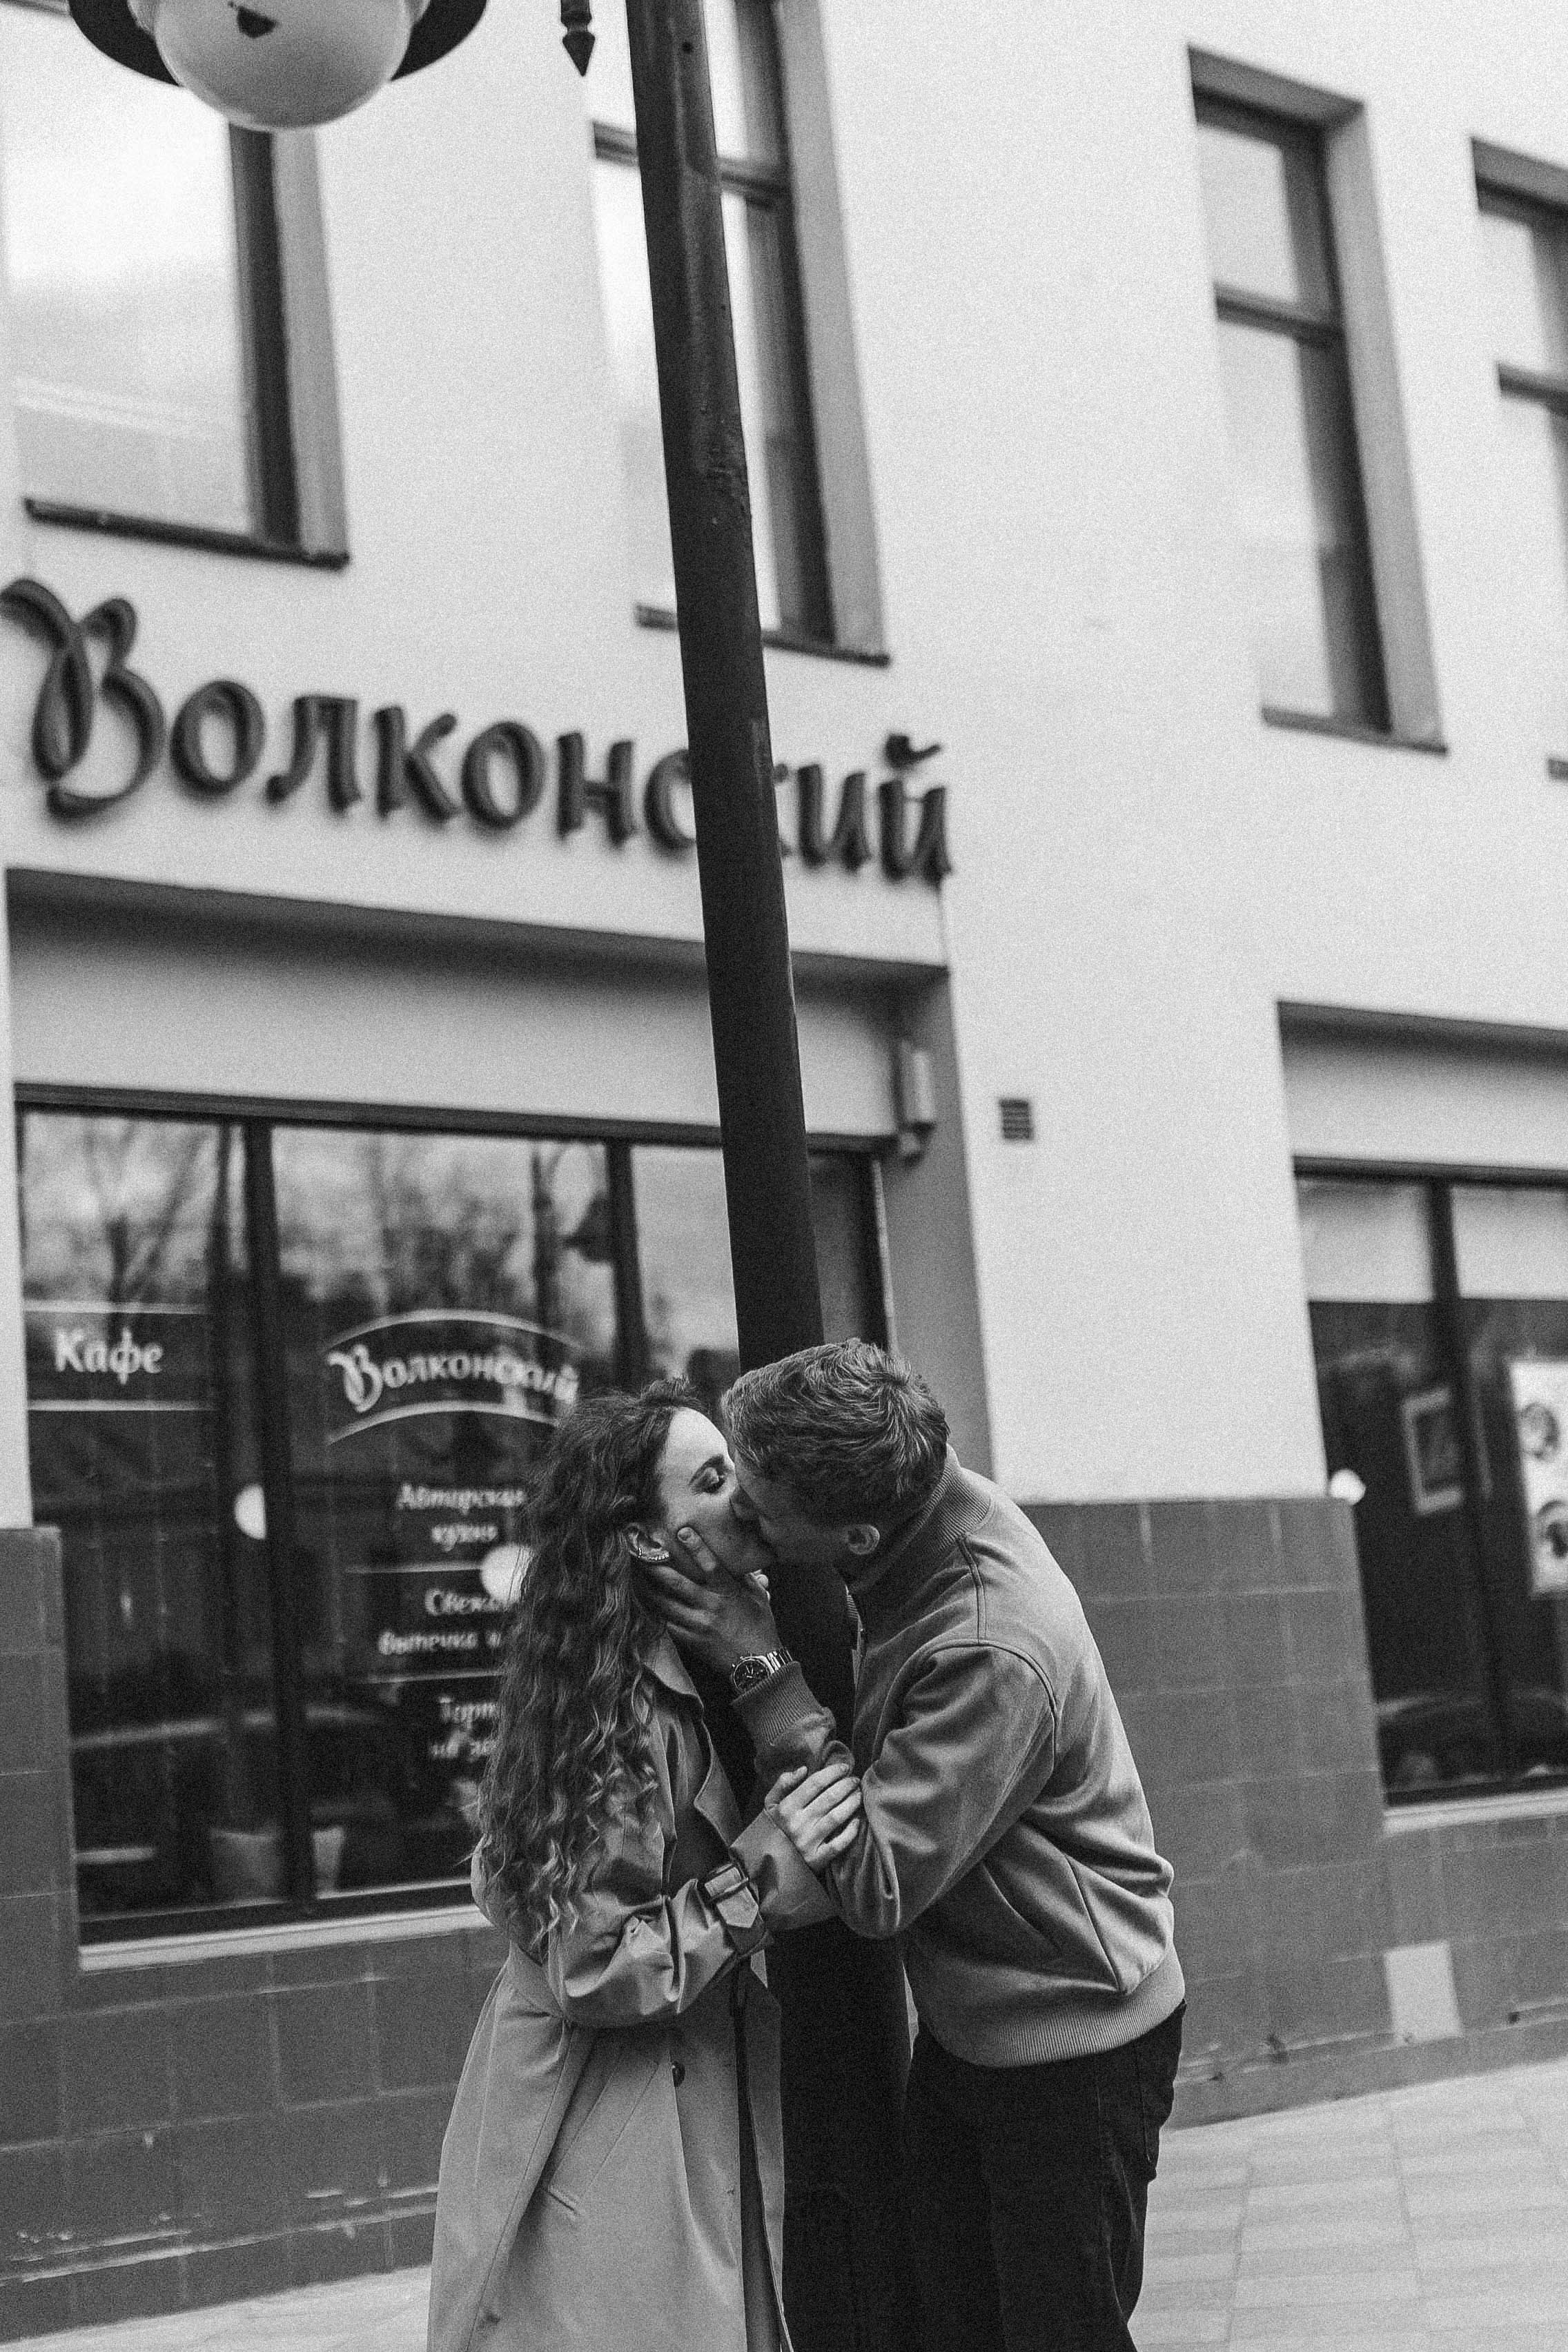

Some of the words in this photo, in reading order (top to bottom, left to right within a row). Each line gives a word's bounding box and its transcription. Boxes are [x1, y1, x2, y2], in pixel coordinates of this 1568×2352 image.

[0, 578, 952, 886] Волконсий
[55, 1326, 164, 1384] Кафе
[424, 1588, 514, 1617] Свежа
